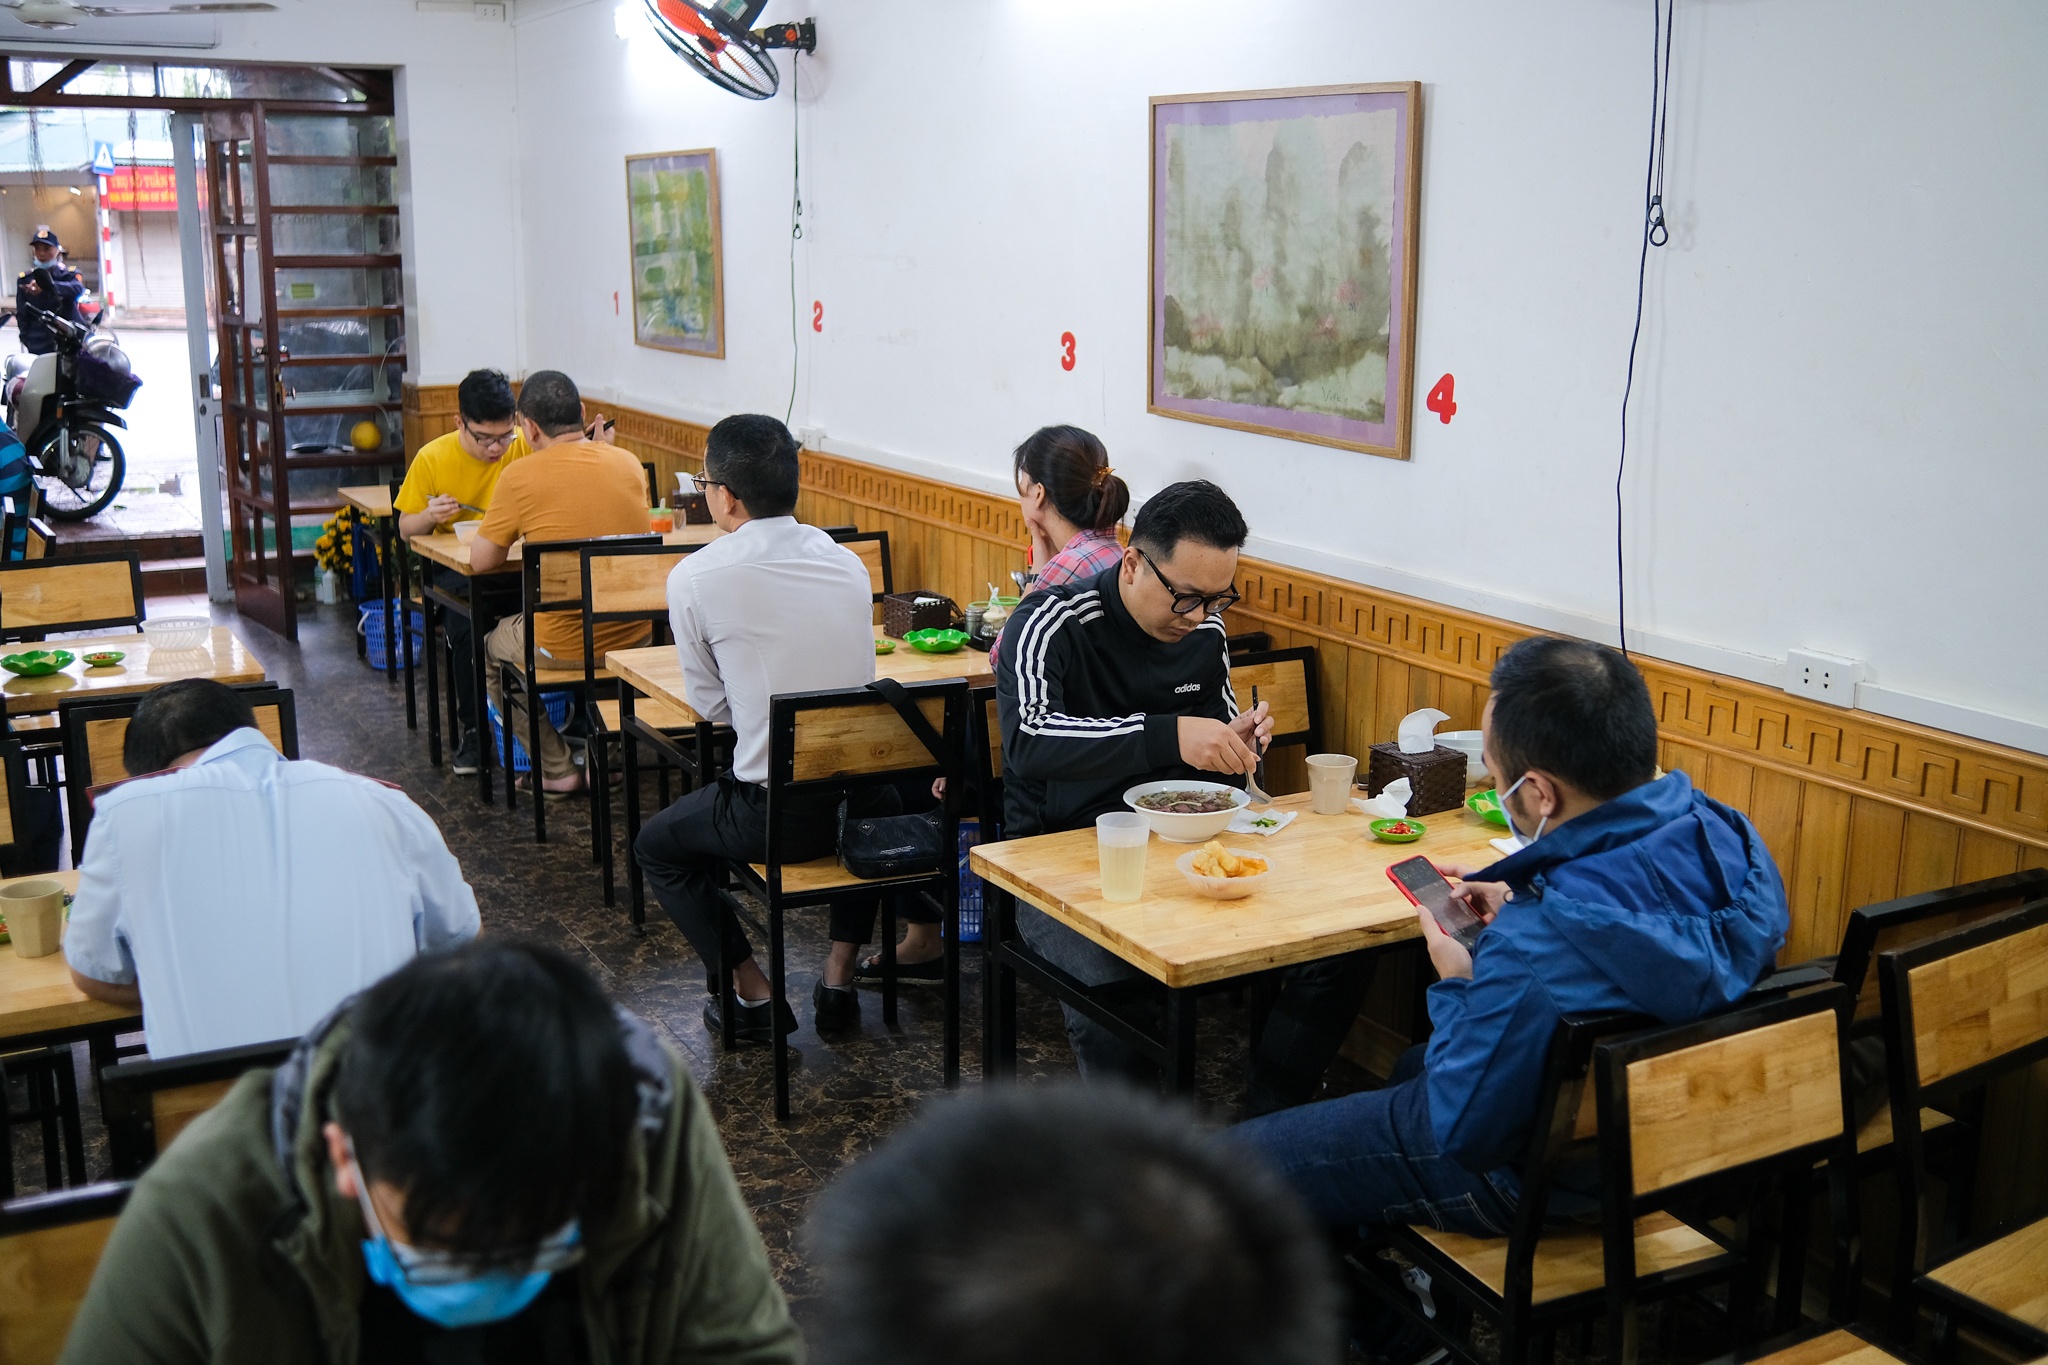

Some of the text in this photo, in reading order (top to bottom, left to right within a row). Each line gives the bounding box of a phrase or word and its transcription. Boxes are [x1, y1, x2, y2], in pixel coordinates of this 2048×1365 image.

[613, 291, 619, 315] 1
[813, 300, 823, 332] 2
[1060, 331, 1076, 372] 3
[1426, 373, 1457, 424] 4
[1174, 683, 1201, 694] adidas
